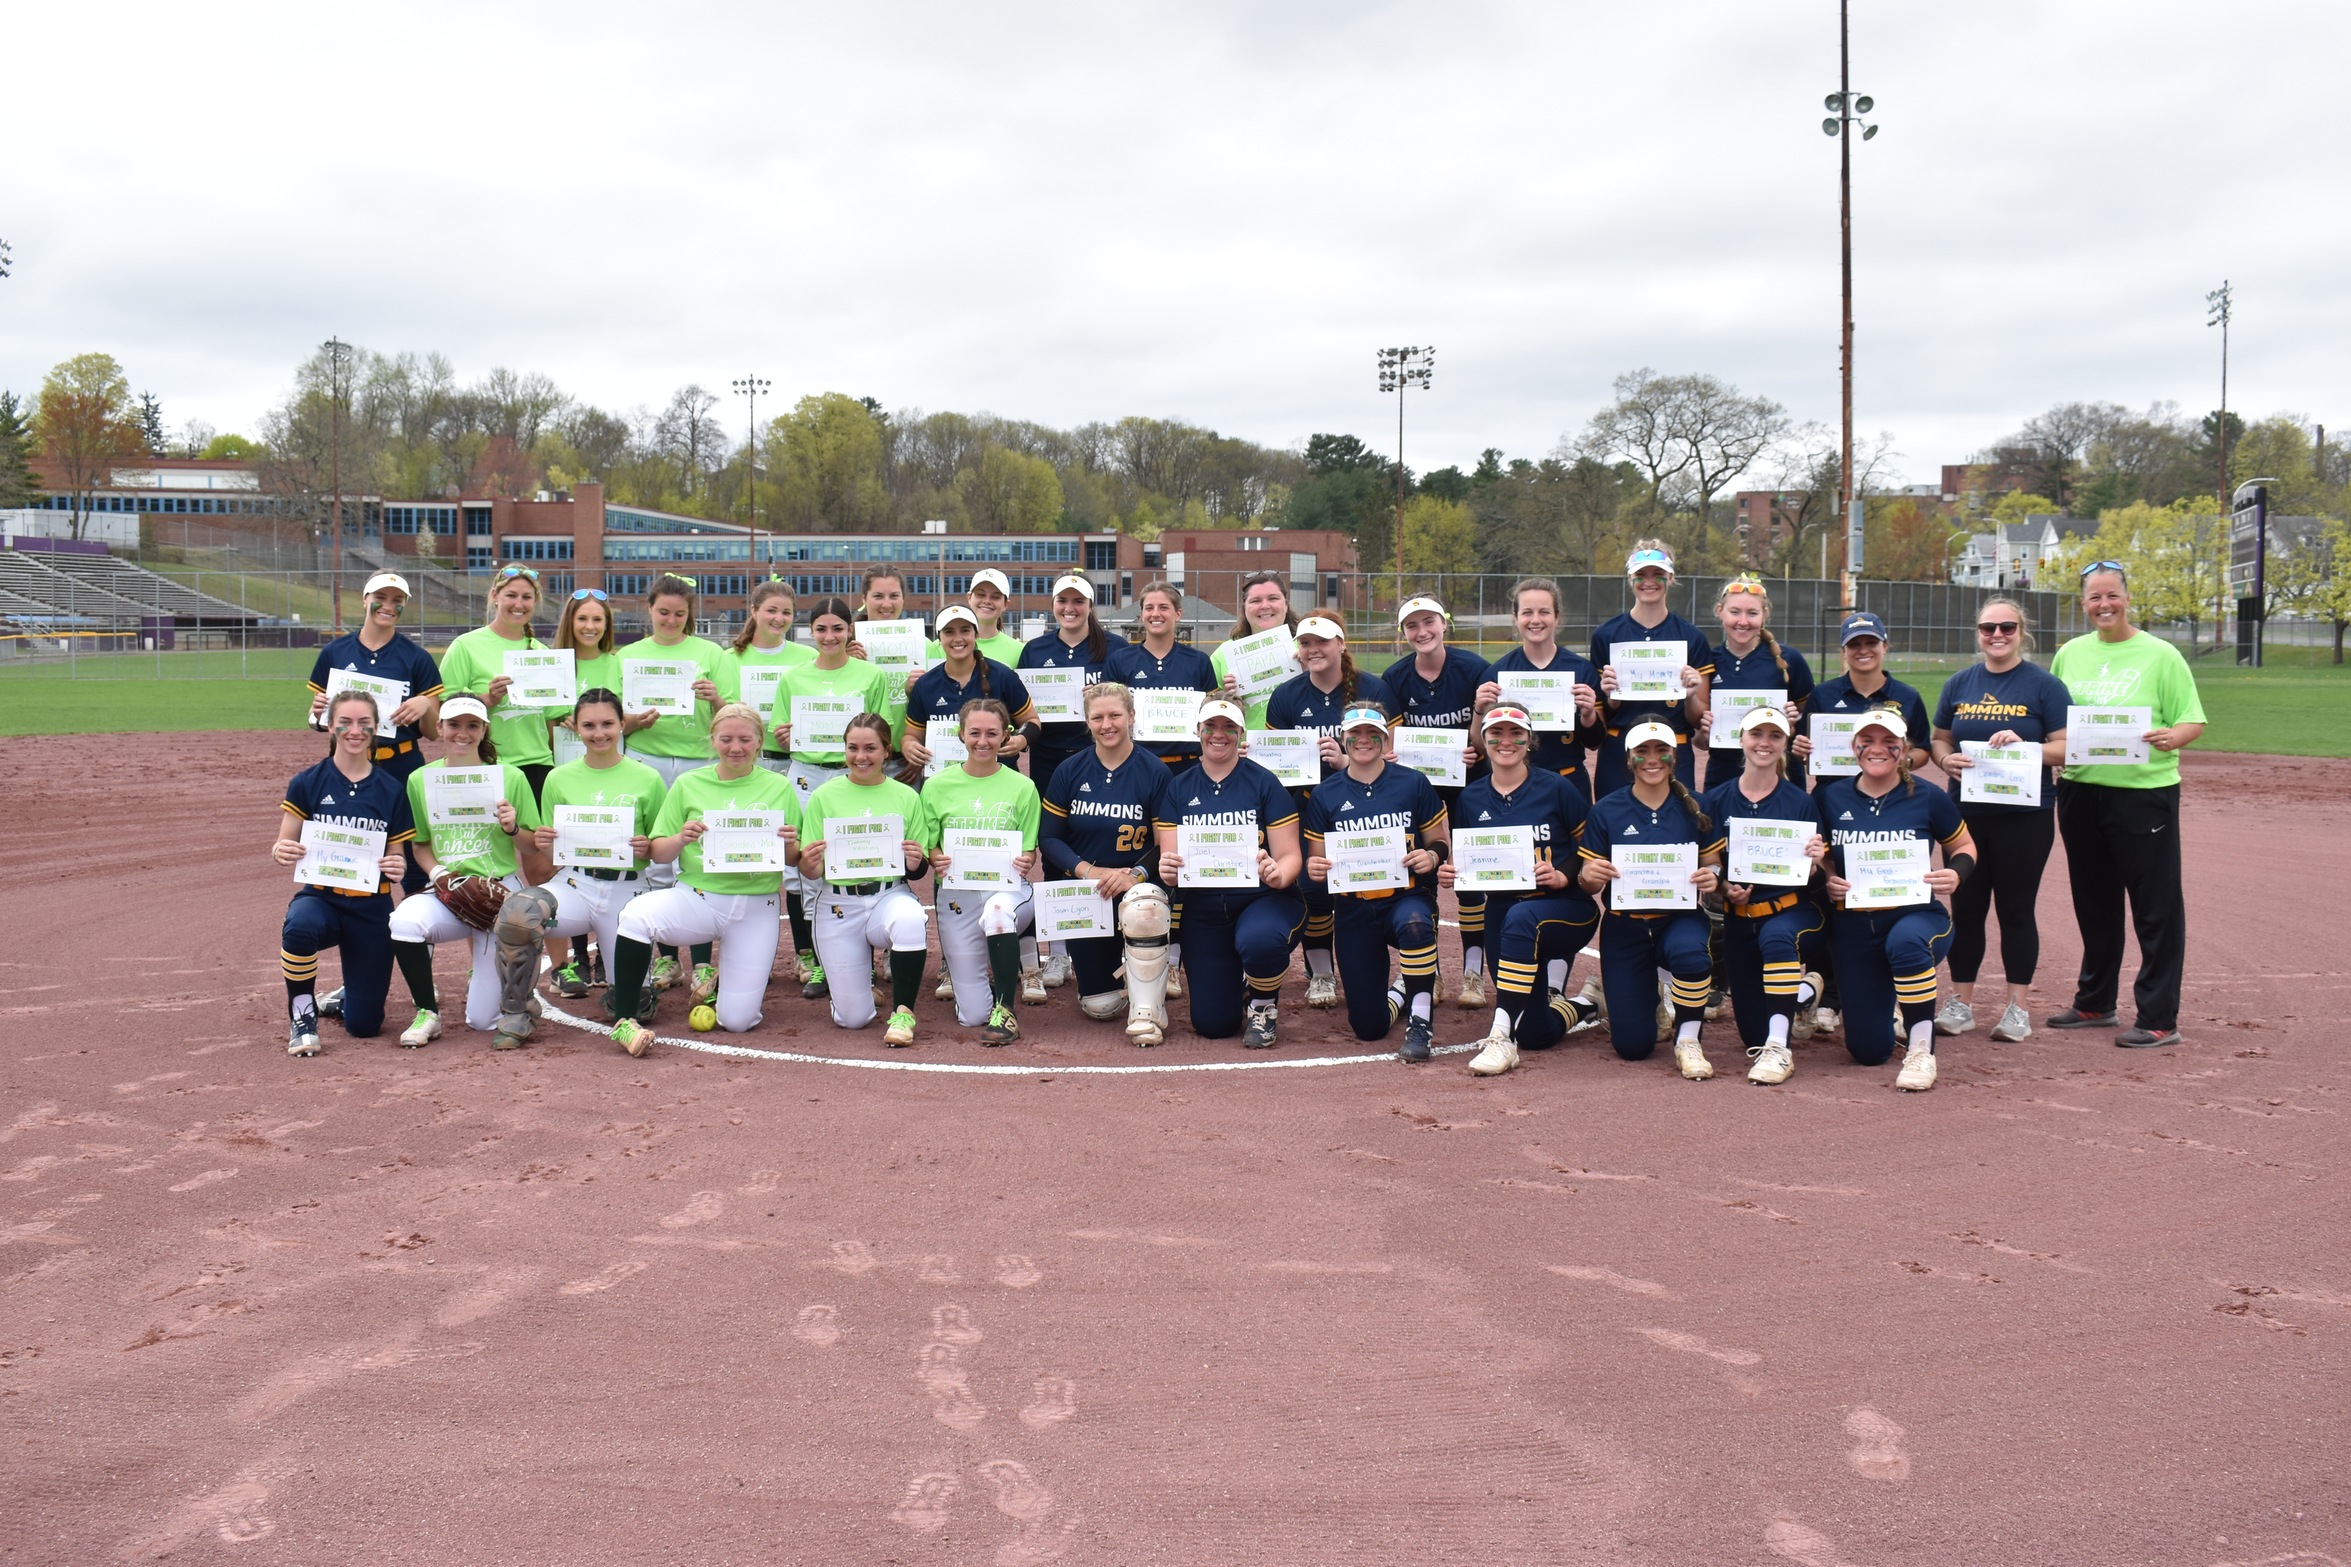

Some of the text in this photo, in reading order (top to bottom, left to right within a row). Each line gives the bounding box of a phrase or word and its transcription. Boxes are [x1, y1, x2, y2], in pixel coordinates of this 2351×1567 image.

[876, 626, 893, 635] FIGHT
[894, 626, 906, 634] FOR
[1243, 640, 1261, 653] FIGHT
[1261, 636, 1274, 647] FOR
[1632, 649, 1652, 658] FIGHT
[1653, 649, 1666, 658] FOR
[524, 657, 541, 666] FIGHT
[543, 656, 555, 665] FOR
[1246, 652, 1277, 673] PAPA
[644, 666, 663, 675] FIGHT
[664, 667, 676, 675] FOR
[761, 672, 778, 681] FIGHT
[1035, 675, 1053, 684] FIGHT
[1054, 674, 1066, 683] FOR
[351, 679, 370, 691] FIGHT
[370, 683, 383, 693] FOR
[1520, 679, 1540, 688] FIGHT
[1541, 679, 1554, 688] FOR
[1155, 696, 1173, 704] FIGHT
[1174, 696, 1187, 704] FOR
[1733, 697, 1752, 706] FIGHT
[1753, 697, 1766, 706] FOR
[812, 702, 831, 712] FIGHT
[832, 703, 845, 712] FOR
[1147, 708, 1188, 718] BRUCE
[1402, 706, 1472, 728] SIMMONS
[1958, 714, 2011, 722] SOFTBALL
[2092, 714, 2113, 724] FIGHT
[2115, 715, 2129, 724] FOR
[1834, 722, 1854, 732] FIGHT
[1267, 736, 1287, 746] FIGHT
[1287, 736, 1300, 746] FOR
[1415, 734, 1434, 744] FIGHT
[1435, 735, 1448, 744] FOR
[1430, 755, 1444, 764] Dog
[1985, 750, 2005, 760] FIGHT
[2007, 750, 2021, 760] FOR
[447, 774, 467, 784] FIGHT
[468, 774, 482, 783] FOR
[1070, 799, 1144, 821] SIMMONS
[578, 813, 598, 823] FIGHT
[599, 814, 613, 823] FOR
[1182, 809, 1258, 826] SIMMONS
[1334, 811, 1413, 832] SIMMONS
[727, 818, 748, 828] FIGHT
[749, 818, 763, 828] FOR
[946, 816, 1006, 832] STRIKE
[847, 824, 867, 834] FIGHT
[869, 823, 882, 833] FOR
[1755, 827, 1777, 837] FIGHT
[1778, 828, 1793, 839] FOR
[326, 831, 348, 843] FIGHT
[348, 835, 364, 846] FOR
[967, 837, 987, 847] FIGHT
[988, 837, 1001, 847] FOR
[1115, 823, 1149, 852] 20
[1201, 833, 1221, 843] FIGHT
[1222, 833, 1237, 843] FOR
[1348, 837, 1369, 848] FIGHT
[1370, 836, 1384, 847] FOR
[1475, 835, 1495, 846] FIGHT
[1497, 834, 1511, 845] FOR
[1831, 829, 1917, 846] SIMMONS
[434, 833, 493, 854] Cancer
[1195, 848, 1211, 856] Joel
[1869, 850, 1890, 861] FIGHT
[1892, 849, 1906, 859] FOR
[316, 850, 328, 866] My
[1213, 858, 1245, 868] Christine
[1469, 854, 1502, 865] Jeanine
[1637, 853, 1659, 863] FIGHT
[1660, 853, 1675, 863] FOR
[1057, 887, 1076, 897] FIGHT
[1078, 886, 1092, 896] FOR
[1070, 904, 1090, 916] Lyon
